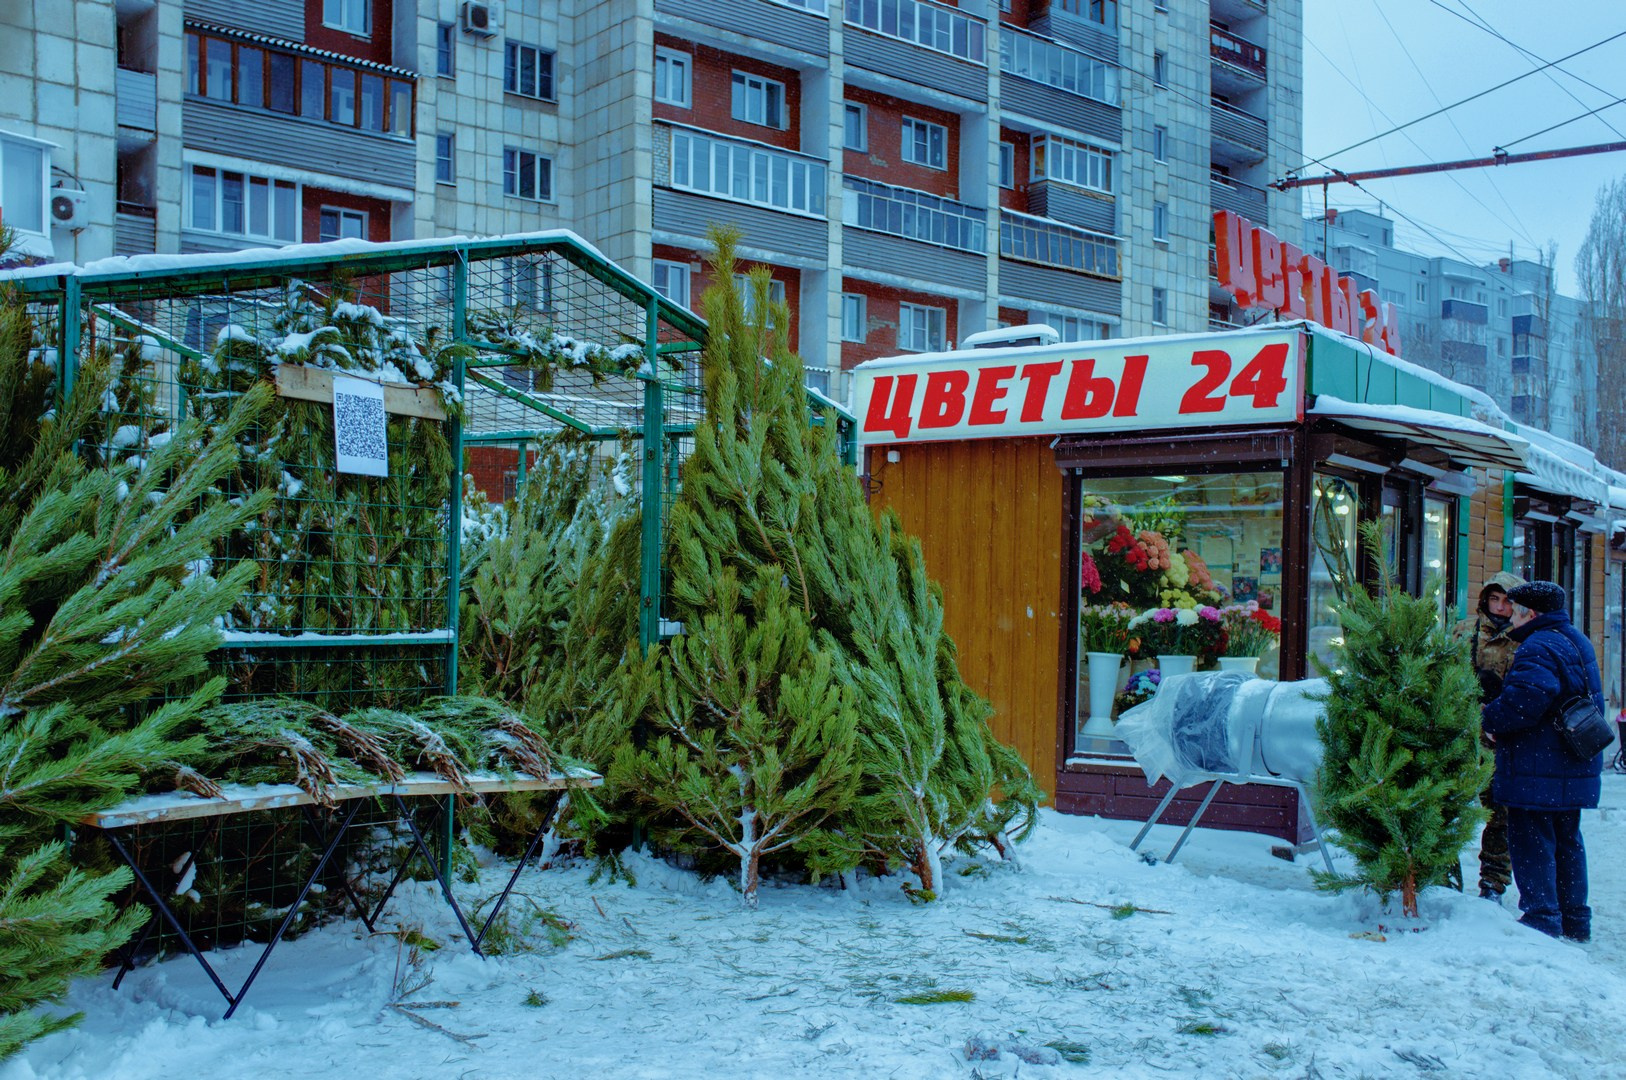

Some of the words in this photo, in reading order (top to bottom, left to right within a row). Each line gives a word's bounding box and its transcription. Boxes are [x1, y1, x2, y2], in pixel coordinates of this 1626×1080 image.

[1213, 210, 1360, 339] ЦВЕТЫ
[1359, 288, 1402, 358] 24
[863, 354, 1149, 439] ЦВЕТЫ
[1178, 343, 1290, 415] 24
